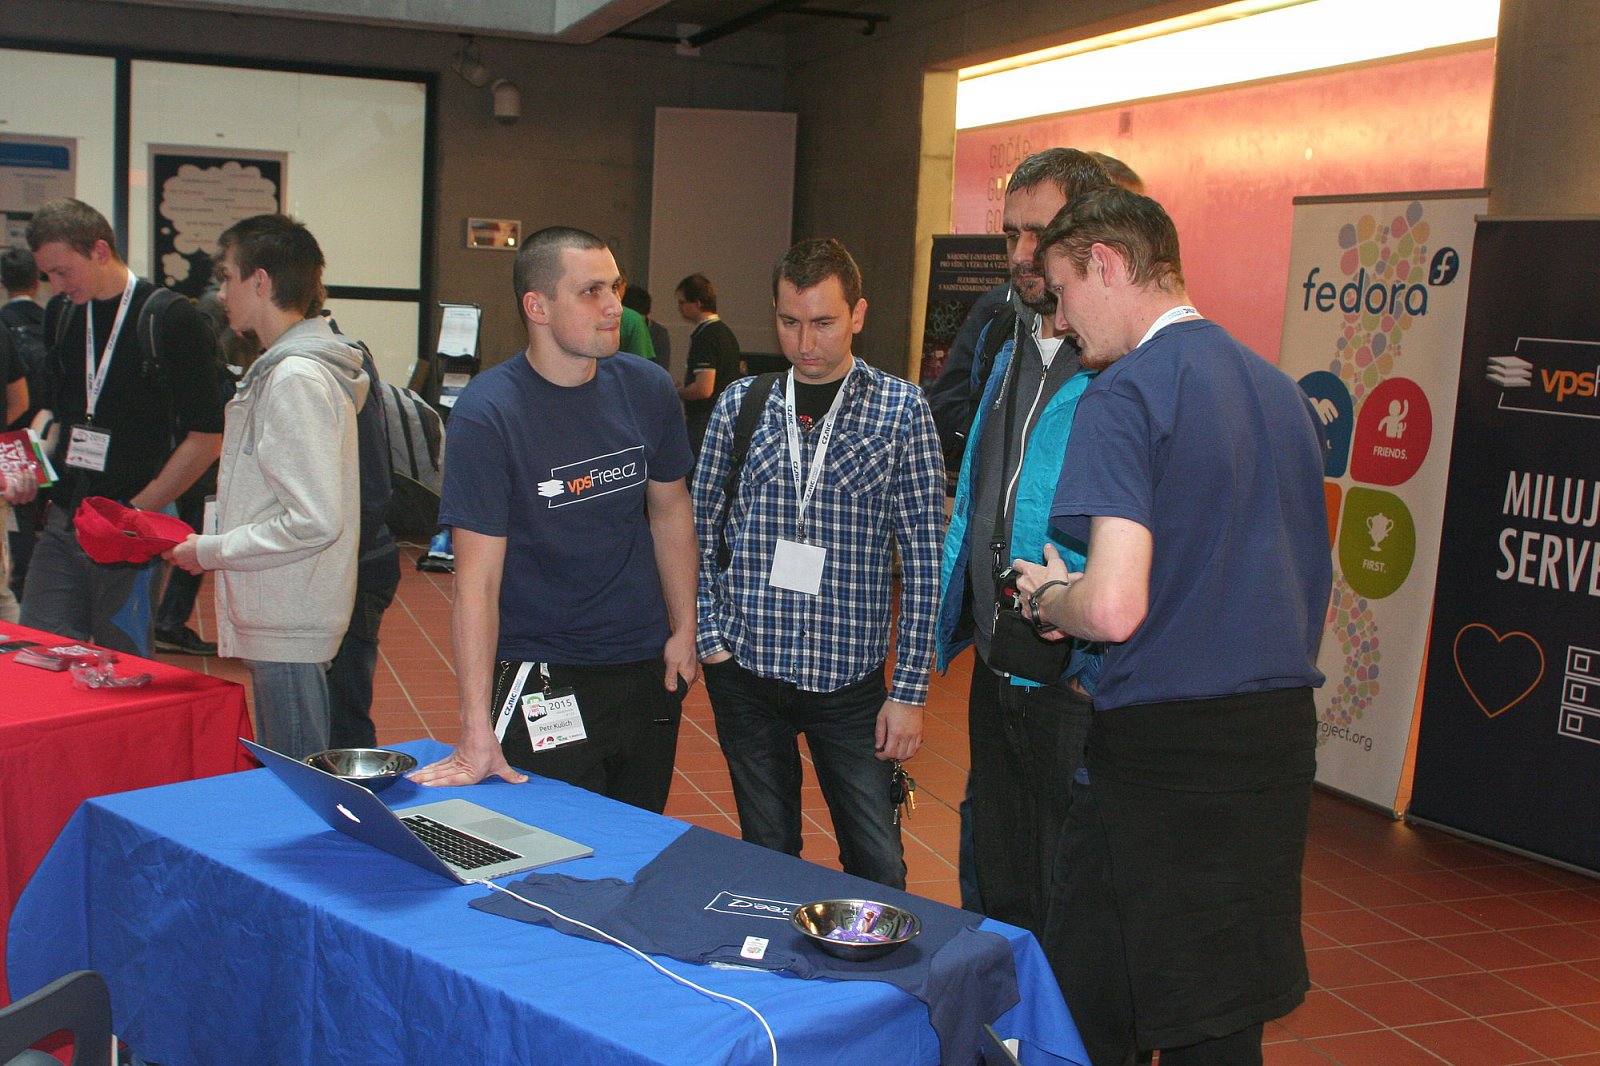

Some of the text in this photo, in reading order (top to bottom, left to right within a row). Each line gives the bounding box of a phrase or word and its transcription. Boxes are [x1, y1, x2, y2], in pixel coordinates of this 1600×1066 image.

[1303, 267, 1428, 316] fedora
[1373, 445, 1408, 460] FRIENDS.
[566, 462, 637, 496] vpsFree.cz
[1362, 559, 1387, 573] FIRST.
[549, 699, 572, 711] 2015
[539, 720, 573, 732] Petr Kulich
